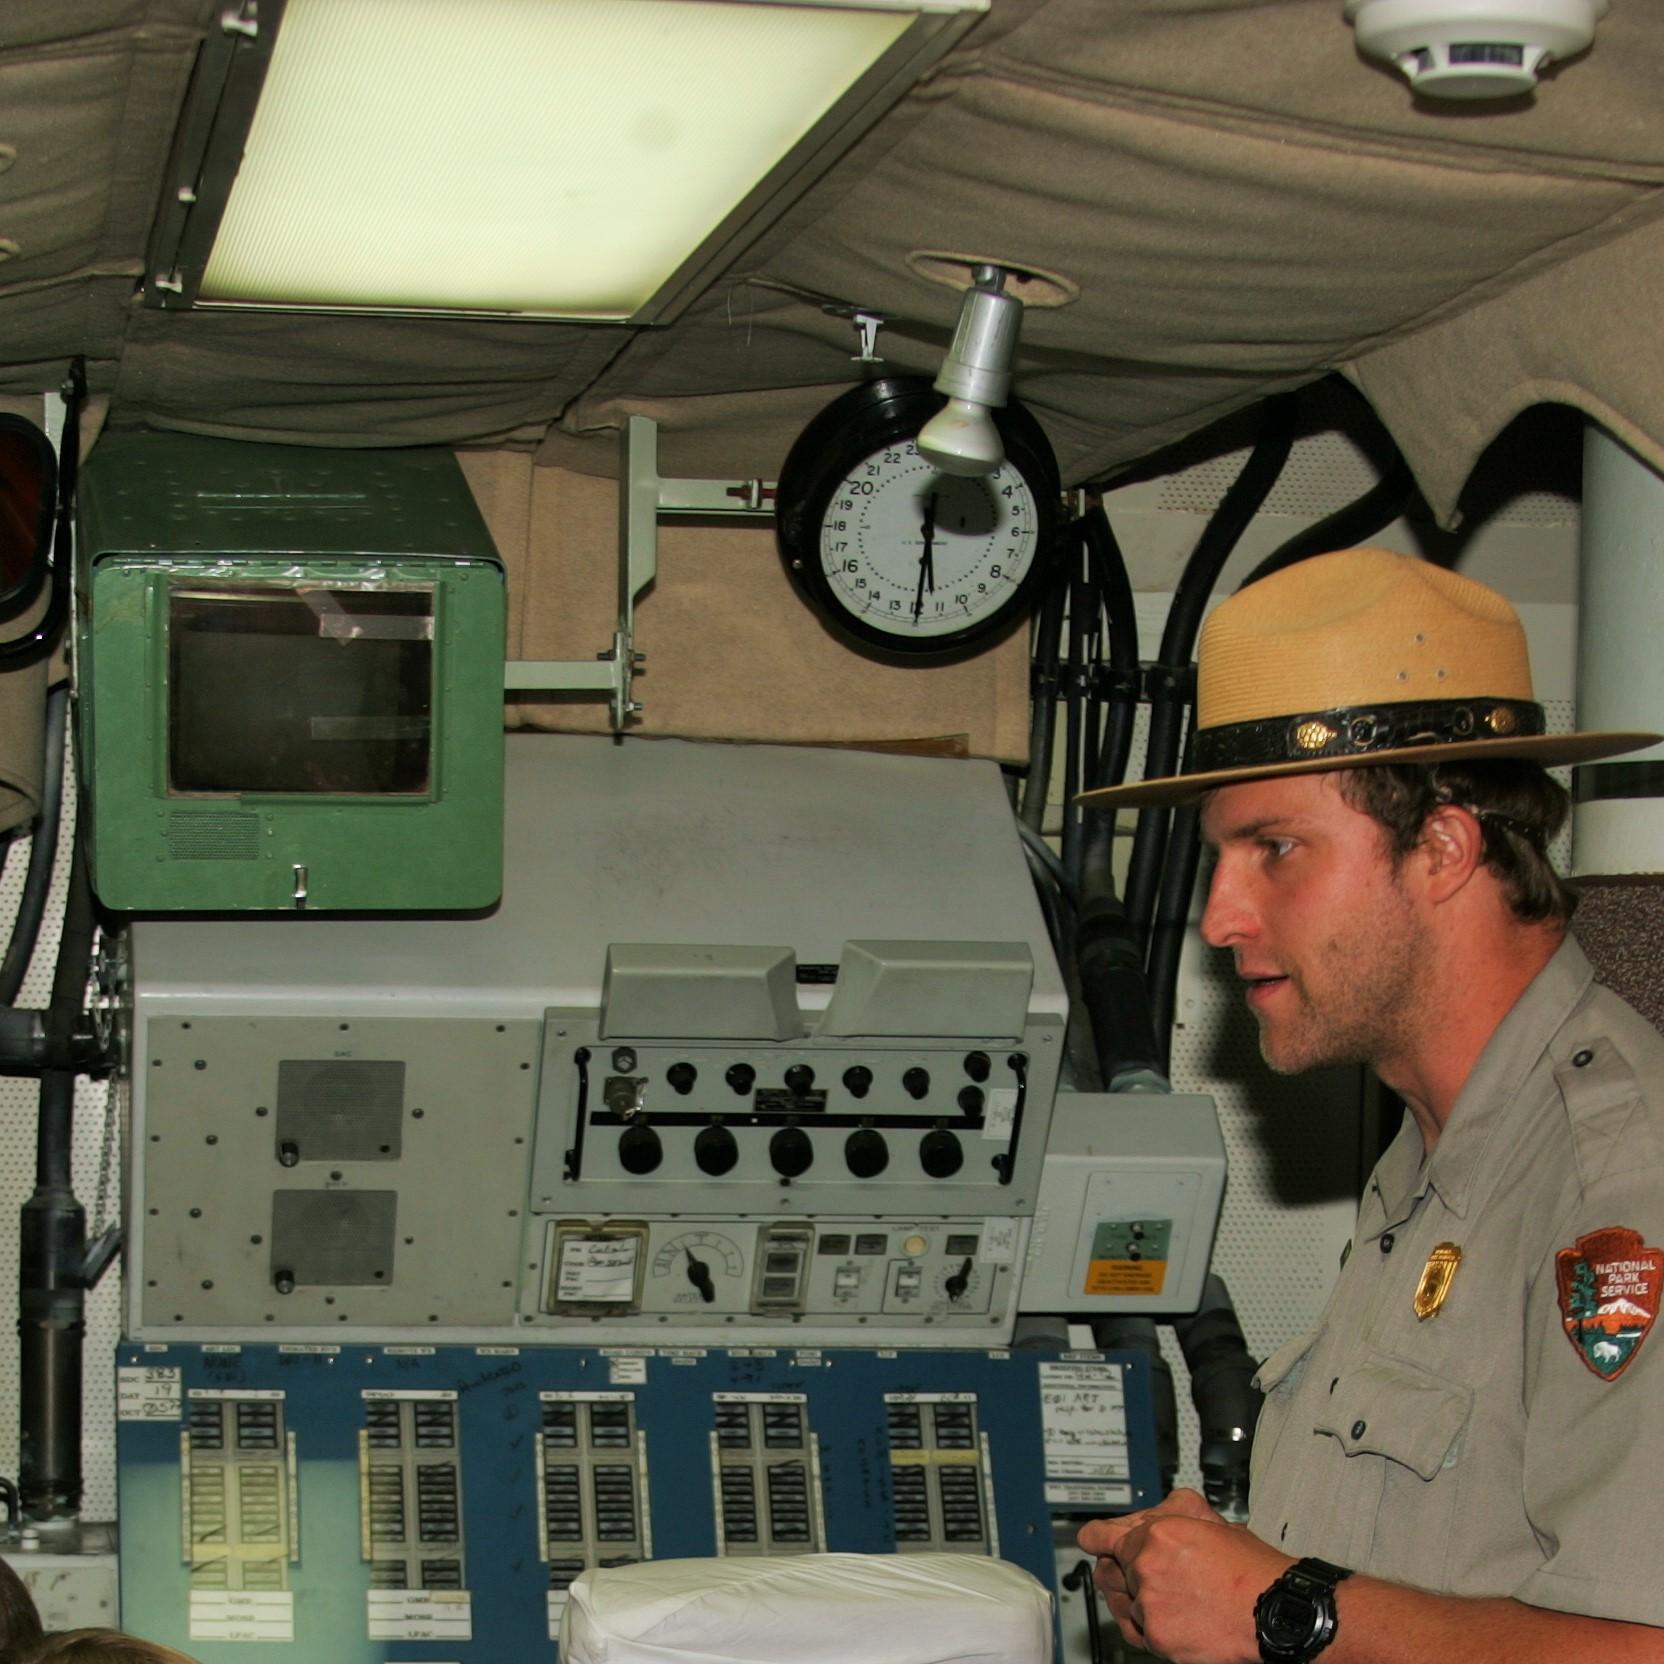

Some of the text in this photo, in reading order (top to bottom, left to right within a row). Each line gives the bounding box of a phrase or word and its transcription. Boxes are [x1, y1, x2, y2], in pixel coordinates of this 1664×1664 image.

[884, 452, 901, 464] 22
[867, 465, 881, 476] 21
[849, 481, 874, 496] 20
[1001, 485, 1013, 498] 4
[839, 500, 853, 511] 19
[1011, 505, 1020, 516] 5
[833, 520, 846, 531] 18
[1011, 526, 1021, 537] 6
[835, 542, 848, 552] 17
[1006, 548, 1016, 559] 7
[842, 559, 859, 573] 16
[989, 564, 1002, 578] 8
[855, 578, 867, 588] 15
[977, 583, 986, 593] 9
[868, 590, 881, 601] 14
[955, 594, 969, 605] 10
[889, 600, 902, 611] 13
[935, 602, 945, 612] 11
[1595, 1259, 1656, 1275] NATIONAL
[1608, 1272, 1641, 1284] PARK
[1600, 1283, 1649, 1297] SERVICE
